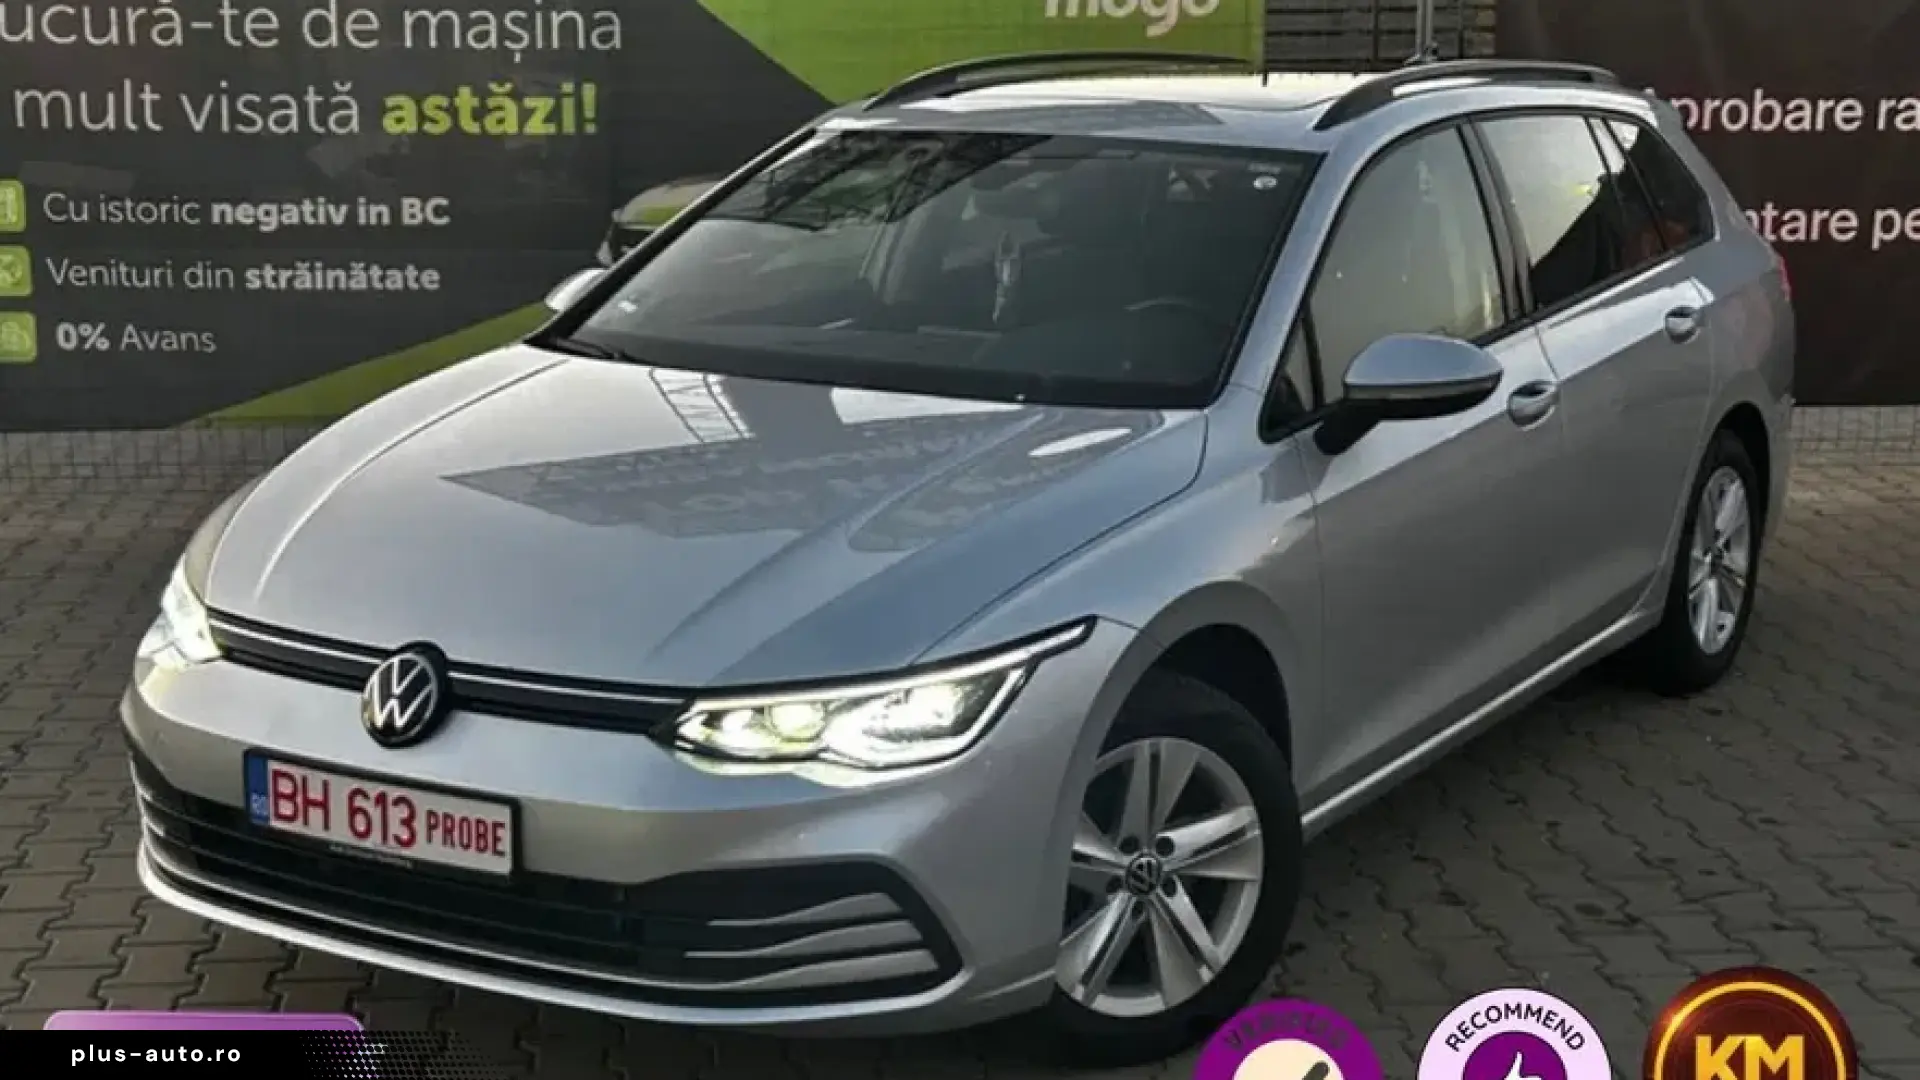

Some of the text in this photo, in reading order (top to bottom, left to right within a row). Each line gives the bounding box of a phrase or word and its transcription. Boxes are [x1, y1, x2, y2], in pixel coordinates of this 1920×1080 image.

[302, 0, 380, 49] de
[14, 78, 598, 135] mult visată astăzi!
[43, 192, 450, 233] Cu istoric negativ in BC
[45, 256, 441, 291] Venituri din străinătate
[55, 321, 217, 353] 0% Avans
[271, 768, 331, 832] BH
[347, 786, 417, 848] 613
[426, 809, 507, 857] PROBE
